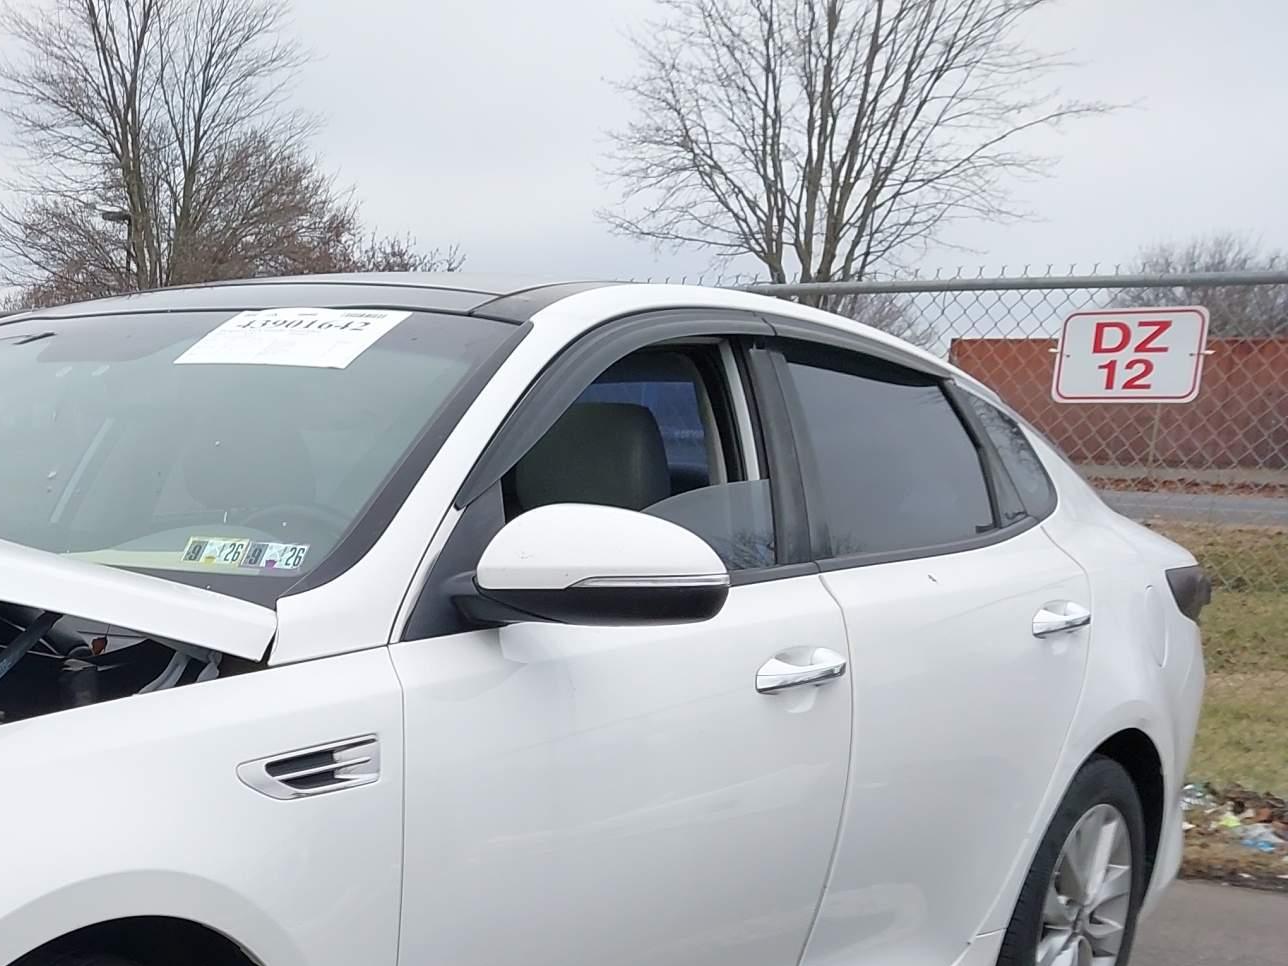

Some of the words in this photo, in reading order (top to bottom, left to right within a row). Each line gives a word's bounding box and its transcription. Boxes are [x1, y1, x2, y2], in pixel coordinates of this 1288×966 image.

[1092, 320, 1173, 354] DZ
[1097, 359, 1154, 390] 12
[223, 543, 244, 562] 26
[285, 547, 306, 567] 26
